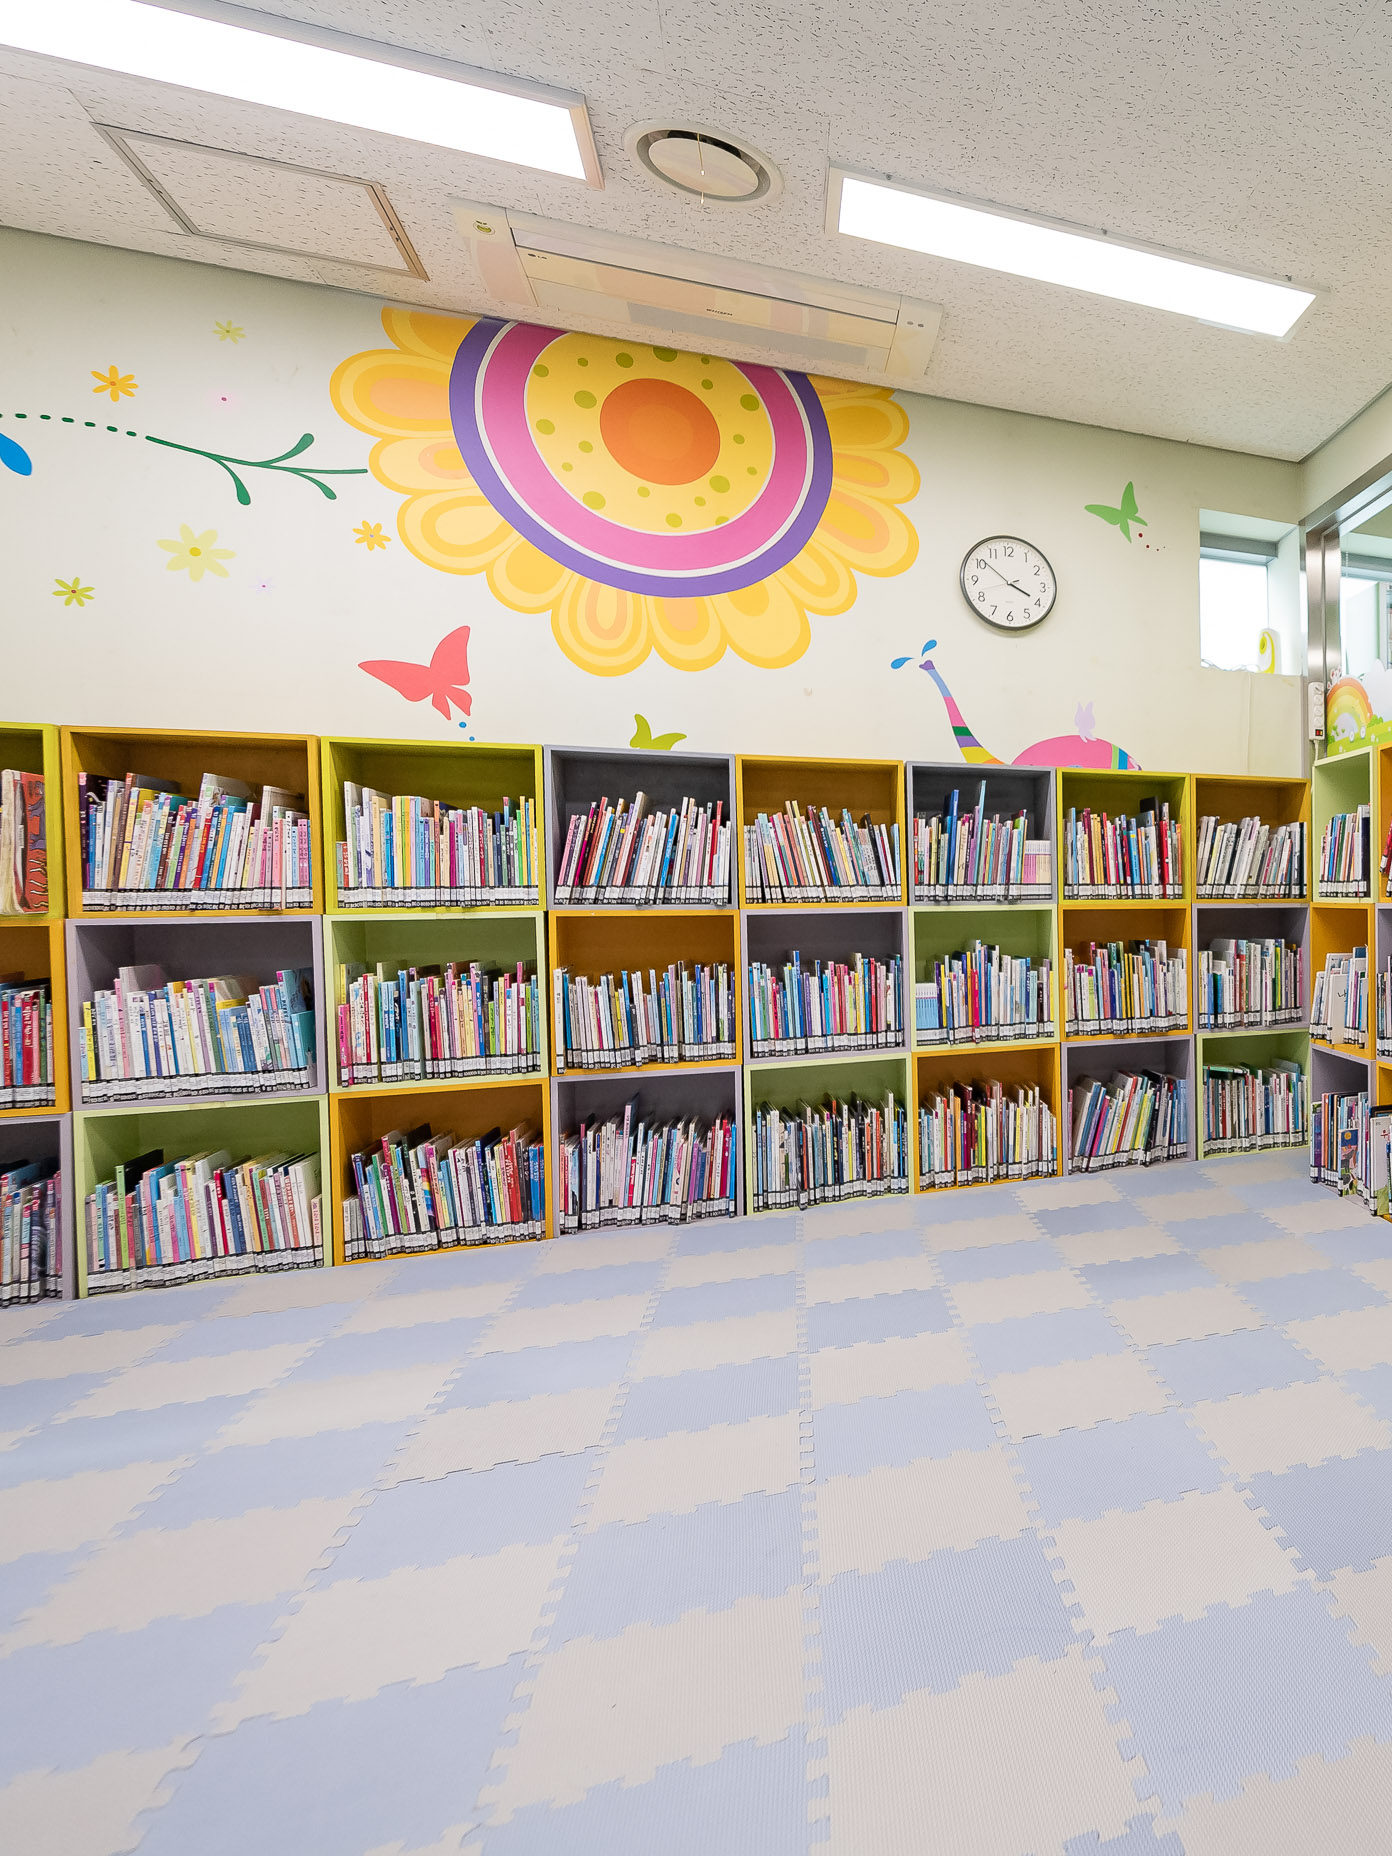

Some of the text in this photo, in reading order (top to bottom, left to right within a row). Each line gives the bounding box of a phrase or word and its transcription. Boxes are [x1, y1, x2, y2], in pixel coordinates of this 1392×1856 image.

[989, 548, 998, 559] 11
[1003, 545, 1014, 557] 12
[976, 558, 987, 569] 10
[1033, 565, 1040, 576] 2
[971, 574, 978, 586] 9
[1040, 582, 1046, 593] 3
[977, 591, 985, 602] 8
[1034, 598, 1041, 608] 4
[990, 604, 998, 615] 7
[1023, 608, 1031, 619] 5
[1006, 611, 1014, 622] 6
